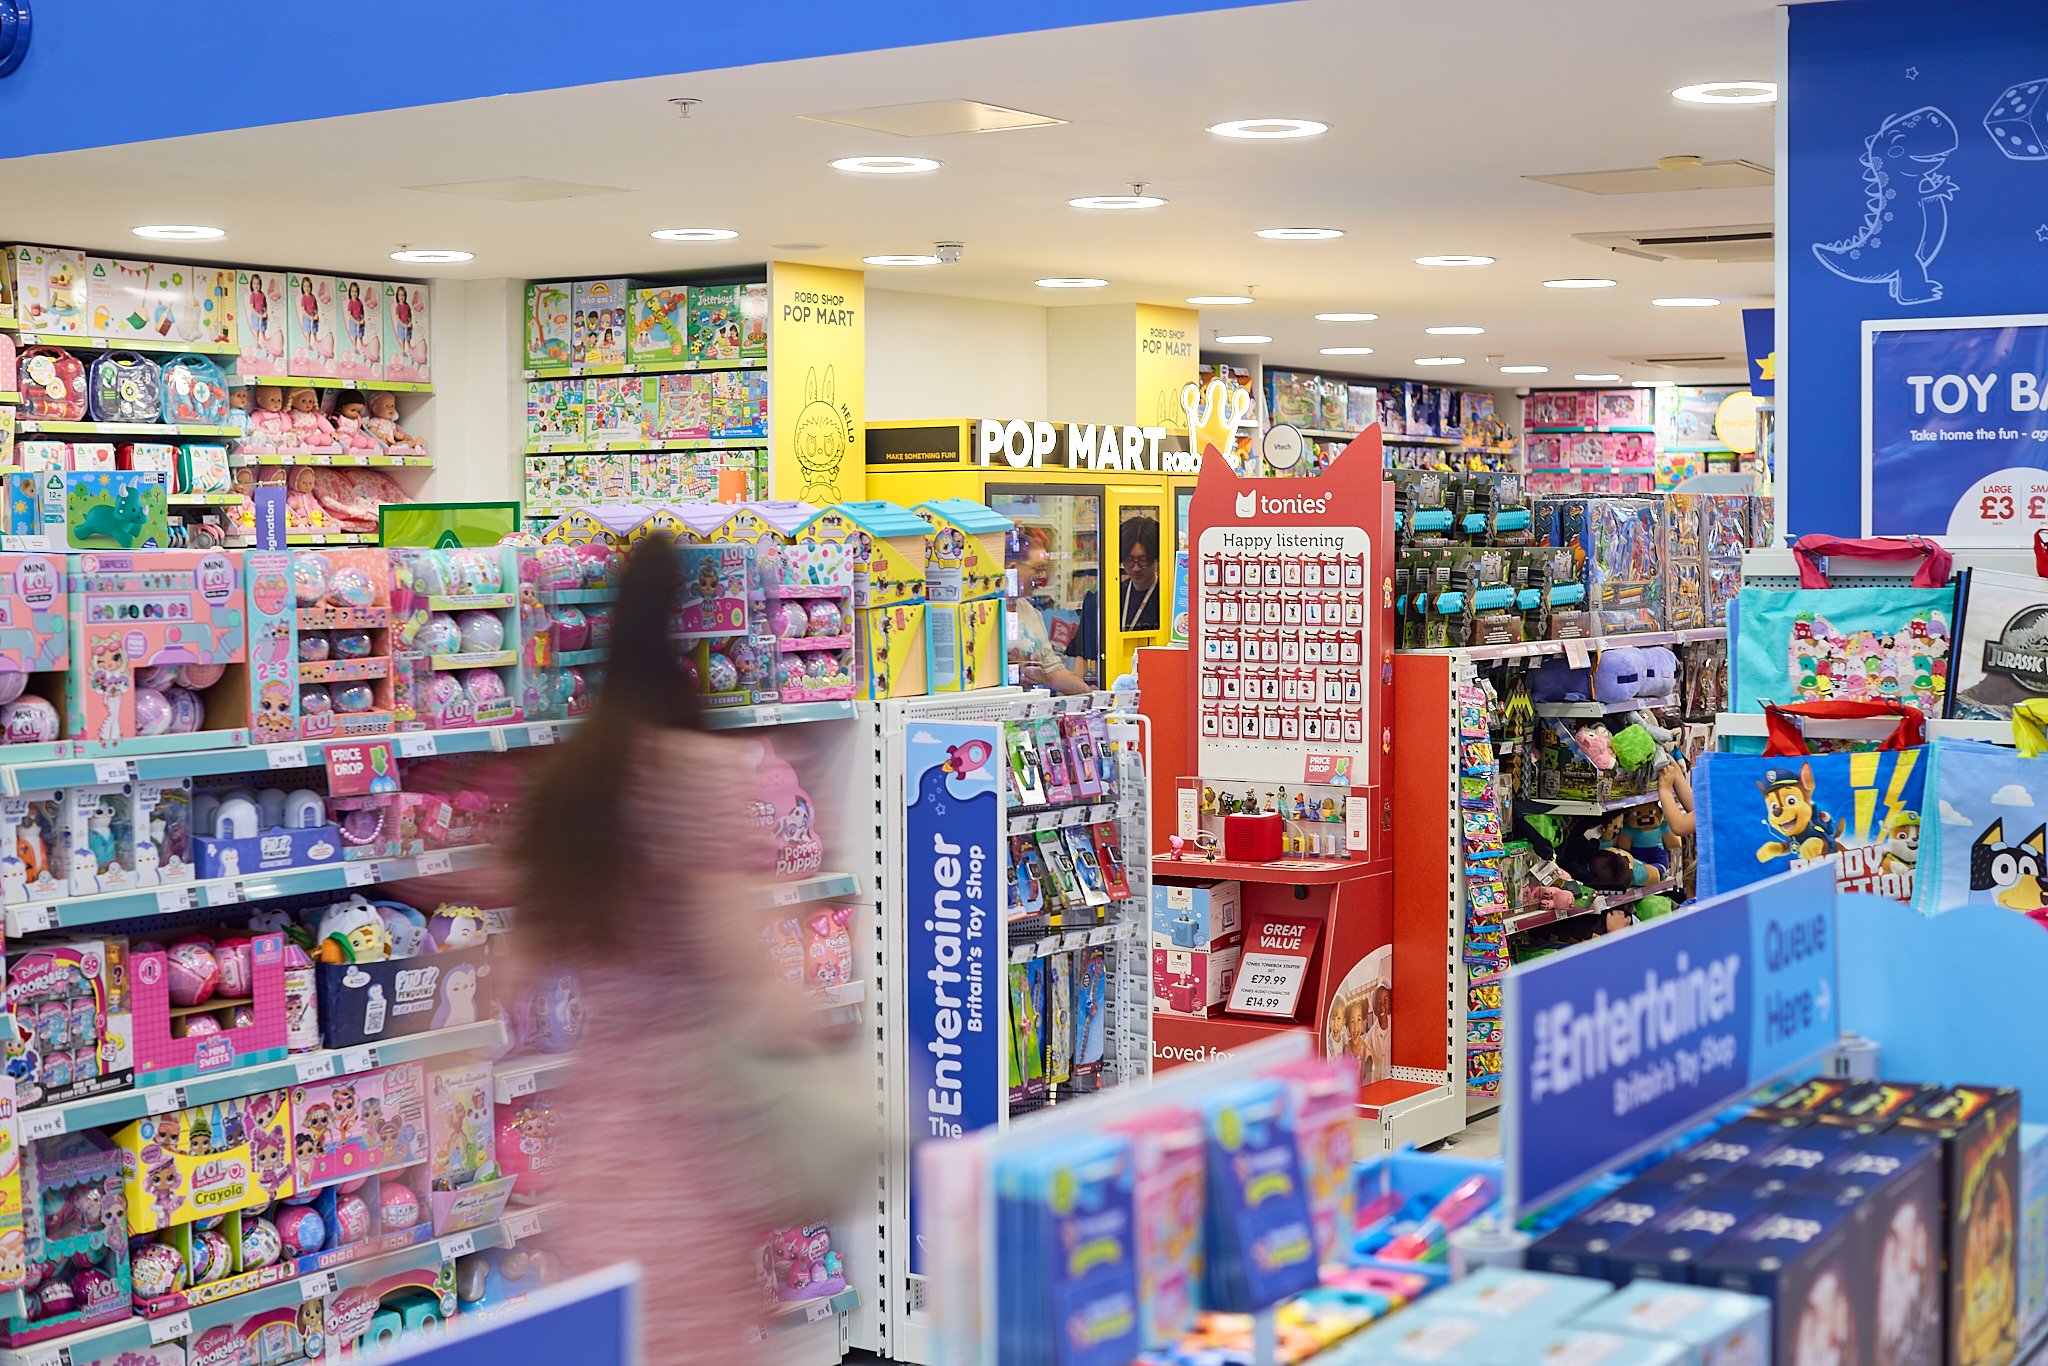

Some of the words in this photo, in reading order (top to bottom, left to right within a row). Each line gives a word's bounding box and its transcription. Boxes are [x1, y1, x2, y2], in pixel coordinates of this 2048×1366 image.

[794, 292, 818, 302] ROBO
[822, 294, 844, 305] SHOP
[784, 304, 811, 321] POP
[817, 307, 854, 327] MART
[1150, 328, 1167, 338] ROBO
[1169, 330, 1185, 340] SHOP
[1142, 340, 1162, 354] POP
[1166, 342, 1192, 357] MART
[1907, 373, 1998, 414] TOY
[2011, 372, 2048, 412] B
[840, 403, 856, 443] HELLO
[1910, 430, 1938, 441] Take
[1940, 429, 1974, 440] home
[1976, 428, 1996, 440] the
[1998, 428, 2018, 440] fun
[2031, 430, 2048, 442] ag
[980, 419, 1057, 469] POP
[1069, 423, 1166, 472] MART
[1163, 451, 1202, 473] ROBO
[886, 453, 904, 461] MAKE
[904, 452, 940, 461] SOMETHING
[941, 452, 956, 460] FUN!
[1984, 485, 2012, 494] LARGE
[1980, 496, 2015, 520] £3
[1224, 534, 1272, 550] Happy
[1276, 533, 1344, 550] listening
[24, 564, 46, 574] MINI
[204, 561, 224, 570] MINI
[1988, 648, 2044, 673] JURASSIC
[306, 711, 337, 730] LOL
[344, 724, 388, 734] SURPRISE
[331, 747, 362, 762] PRICE
[1309, 756, 1330, 765] PRICE
[334, 762, 364, 777] DROP
[1308, 764, 1330, 772] DROP
[784, 840, 818, 861] Popping
[776, 850, 821, 877] PUPPIES
[966, 844, 986, 906] Shop
[966, 908, 986, 942] Toy
[1264, 924, 1306, 937] GREAT
[1260, 936, 1302, 950] VALUE
[1764, 912, 1826, 973] Queue
[20, 962, 49, 979] Disney
[925, 832, 962, 1116] Entertainer
[1251, 974, 1286, 985] £79.99
[966, 947, 984, 1033] Britain's
[1246, 996, 1280, 1008] £14.99
[1550, 950, 1741, 1094] Entertainer
[1766, 988, 1814, 1047] Here
[208, 1046, 226, 1057] MINI
[1152, 1040, 1205, 1063] Loved
[199, 1054, 230, 1068] SWEETS
[928, 1117, 962, 1140] The
[195, 1162, 227, 1179] LOL
[194, 1186, 242, 1206] Crayola
